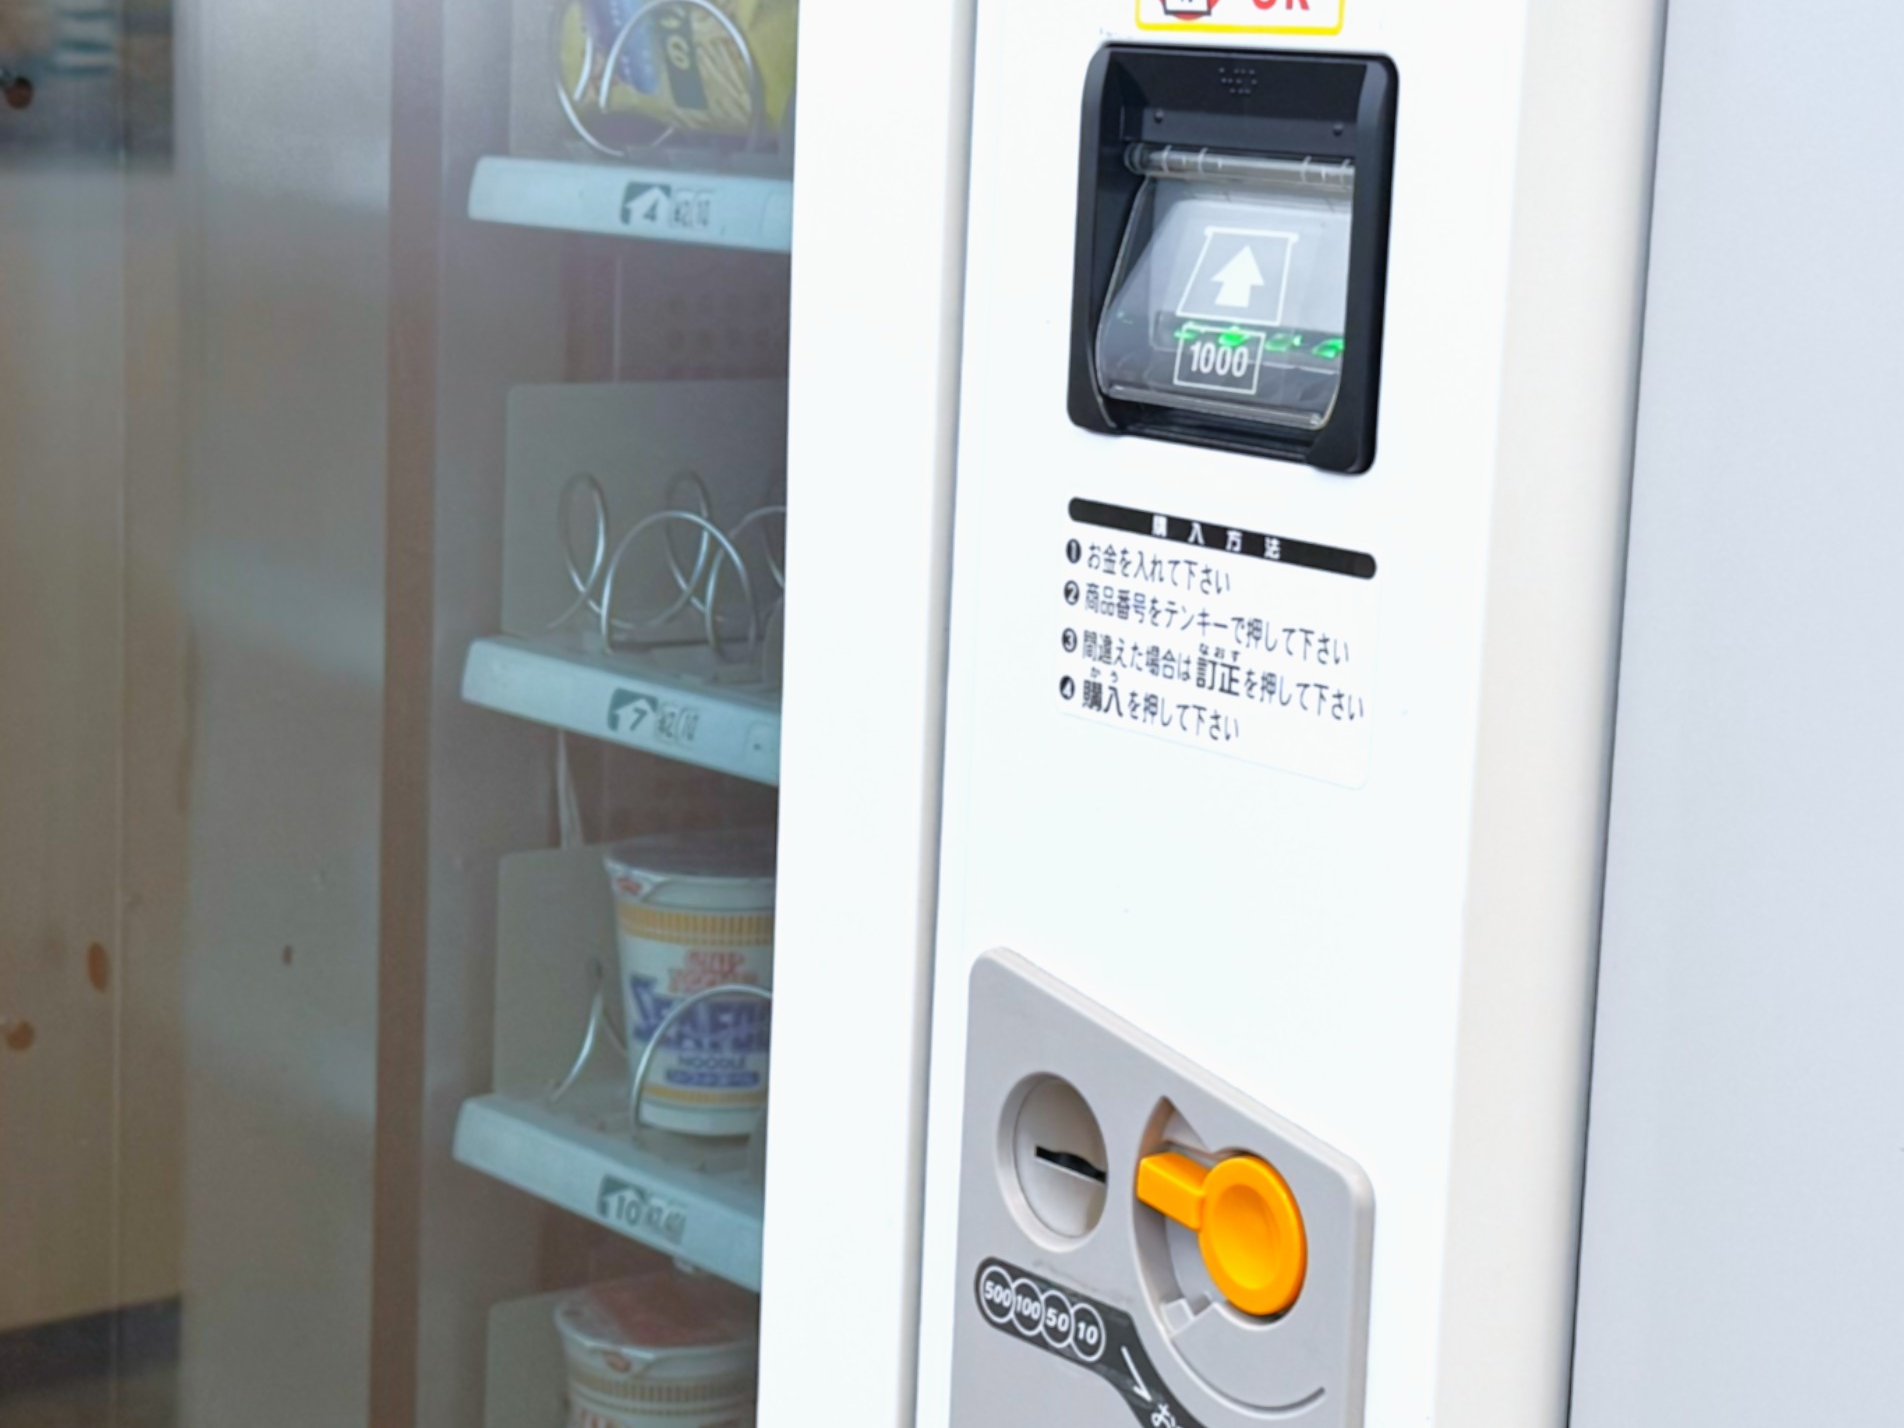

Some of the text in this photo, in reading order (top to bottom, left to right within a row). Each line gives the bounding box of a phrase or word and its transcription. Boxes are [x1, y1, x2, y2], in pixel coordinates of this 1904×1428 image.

[643, 201, 660, 222] 4
[1187, 341, 1252, 379] 1000
[1151, 515, 1282, 560] 購入方法
[1086, 541, 1232, 595] お金を入れて下さい
[1084, 581, 1351, 666] 商品番号をテンキーで押して下さい
[629, 709, 648, 732] 7
[615, 1195, 641, 1226] 10
[983, 1278, 1100, 1346] 500 100 50 10
